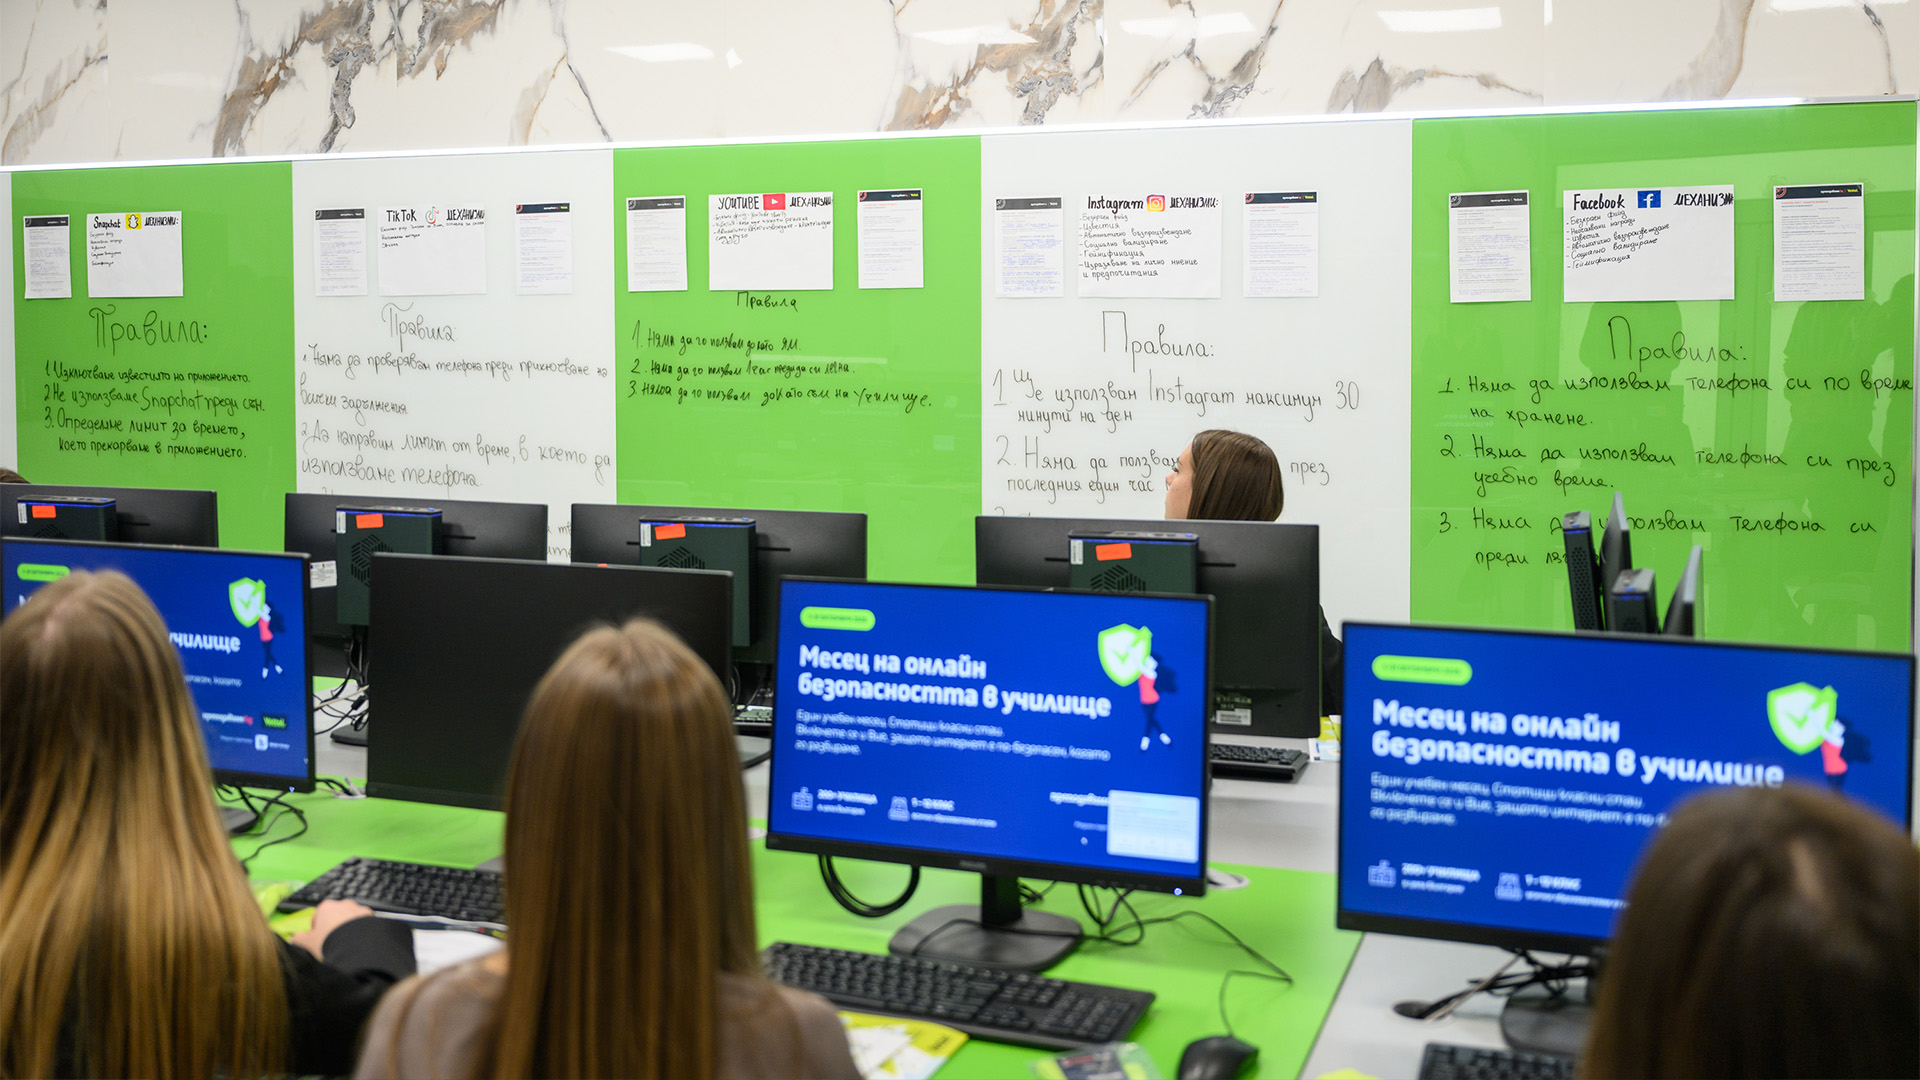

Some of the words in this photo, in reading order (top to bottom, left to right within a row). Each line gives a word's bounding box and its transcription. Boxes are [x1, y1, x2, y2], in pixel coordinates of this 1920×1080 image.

[1087, 195, 1144, 215] Instagram
[1573, 193, 1626, 211] Facebook
[93, 216, 121, 230] Snapchat
[736, 290, 799, 313] Правила
[88, 303, 207, 356] Правила:
[1101, 310, 1215, 373] Правила:
[1607, 315, 1747, 373] Правила:
[678, 335, 693, 356] да
[173, 372, 185, 382] на
[345, 354, 361, 380] да
[485, 360, 513, 382] преди
[676, 366, 690, 381] да
[53, 382, 66, 402] Не
[140, 385, 204, 417] Snapchat
[203, 395, 239, 417] преди
[678, 387, 689, 405] да
[835, 388, 849, 399] на
[1148, 368, 1235, 417] Instagram
[1335, 380, 1360, 410] 30
[1438, 376, 1460, 393] 1.
[1468, 375, 1516, 393] Няма
[1529, 378, 1554, 404] да
[1564, 371, 1671, 392] използвам
[1686, 372, 1772, 398] телефона
[1786, 377, 1811, 391] си
[1824, 376, 1850, 391] по
[129, 419, 167, 433] лимит
[171, 421, 187, 441] за
[1080, 411, 1096, 423] на
[1105, 409, 1133, 434] ден
[1470, 407, 1494, 419] на
[1506, 408, 1593, 429] хранене.
[59, 436, 87, 452] което
[154, 440, 162, 455] в
[452, 441, 471, 454] от
[519, 434, 529, 462] в
[538, 445, 587, 465] което
[594, 453, 611, 486] да
[1440, 434, 1462, 460] 2.
[1472, 433, 1527, 460] Няма
[1540, 447, 1565, 464] да
[1579, 442, 1675, 467] използвам
[1694, 443, 1788, 469] телефона
[1806, 455, 1832, 468] си
[1846, 457, 1896, 487] през
[301, 454, 397, 484] използваме
[1089, 457, 1108, 483] да
[1290, 461, 1330, 486] през
[1474, 465, 1538, 498] учебно
[1554, 469, 1614, 497] време.
[1007, 478, 1083, 504] последния
[1088, 480, 1120, 504] един
[1128, 479, 1155, 492] час
[1439, 511, 1458, 534] 3.
[1472, 506, 1532, 530] Няма
[1729, 511, 1826, 536] телефона
[1850, 521, 1877, 534] си
[1475, 550, 1529, 572] преди
[799, 645, 870, 674] Месец
[873, 650, 901, 673] на
[904, 653, 987, 680] онлайн
[797, 671, 979, 708] безопасността
[982, 683, 999, 709] в
[1000, 689, 1112, 720] училище
[1372, 698, 1467, 736] Месец
[1470, 710, 1508, 735] на
[1511, 713, 1620, 744] онлайн
[1371, 729, 1611, 776] безопасността
[1615, 747, 1636, 777] в
